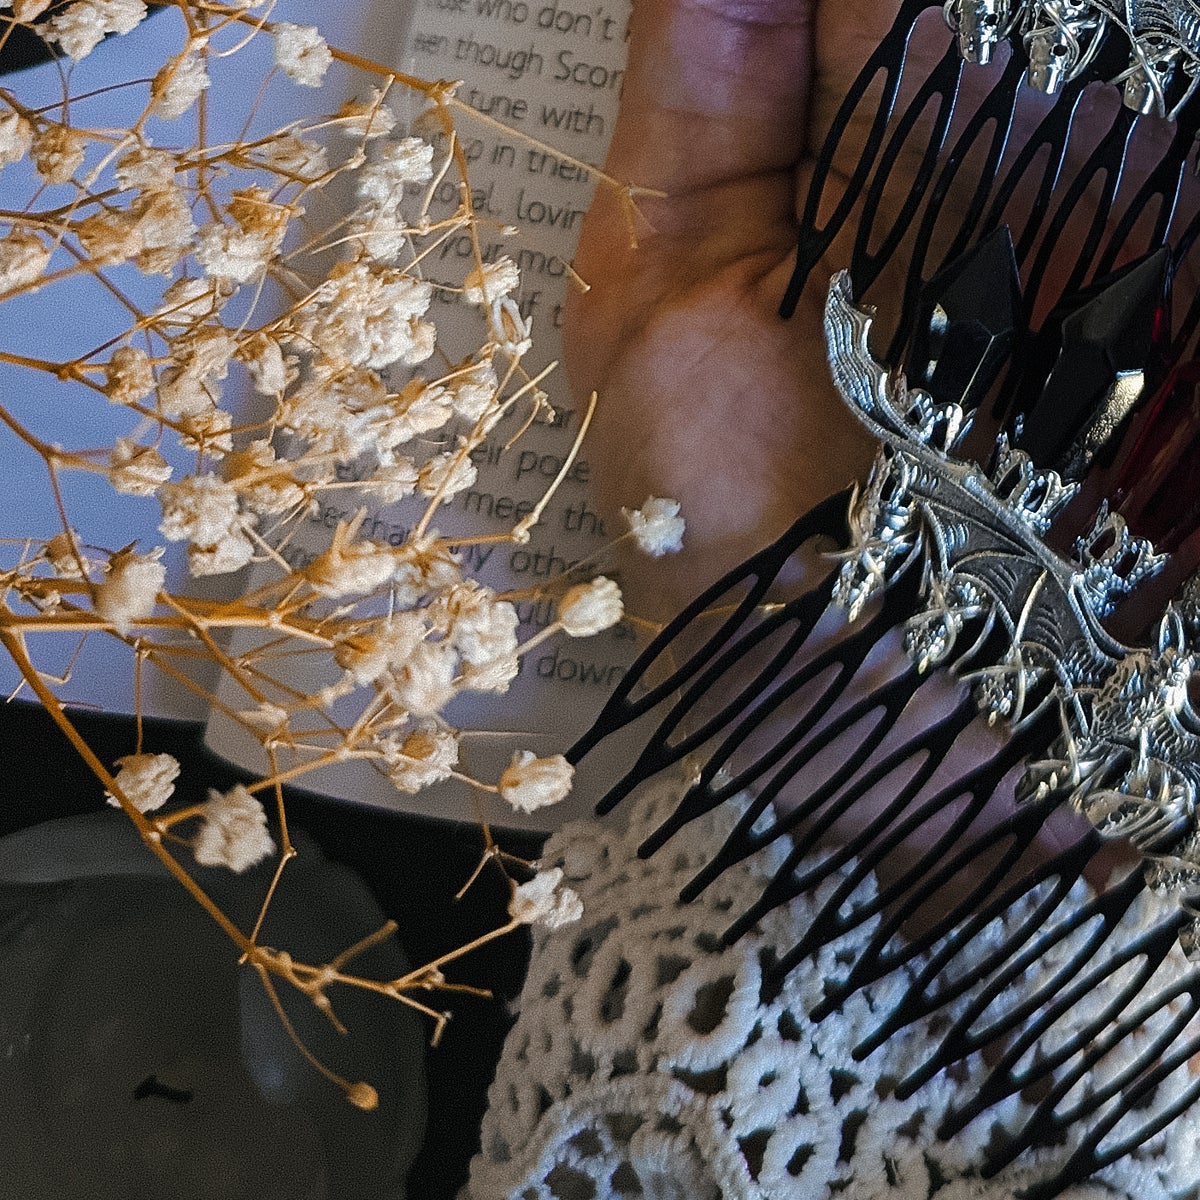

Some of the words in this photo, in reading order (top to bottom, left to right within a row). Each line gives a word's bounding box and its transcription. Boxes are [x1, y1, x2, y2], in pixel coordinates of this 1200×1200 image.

[537, 1, 617, 42] don't
[453, 30, 545, 81] though
[541, 102, 607, 137] with
